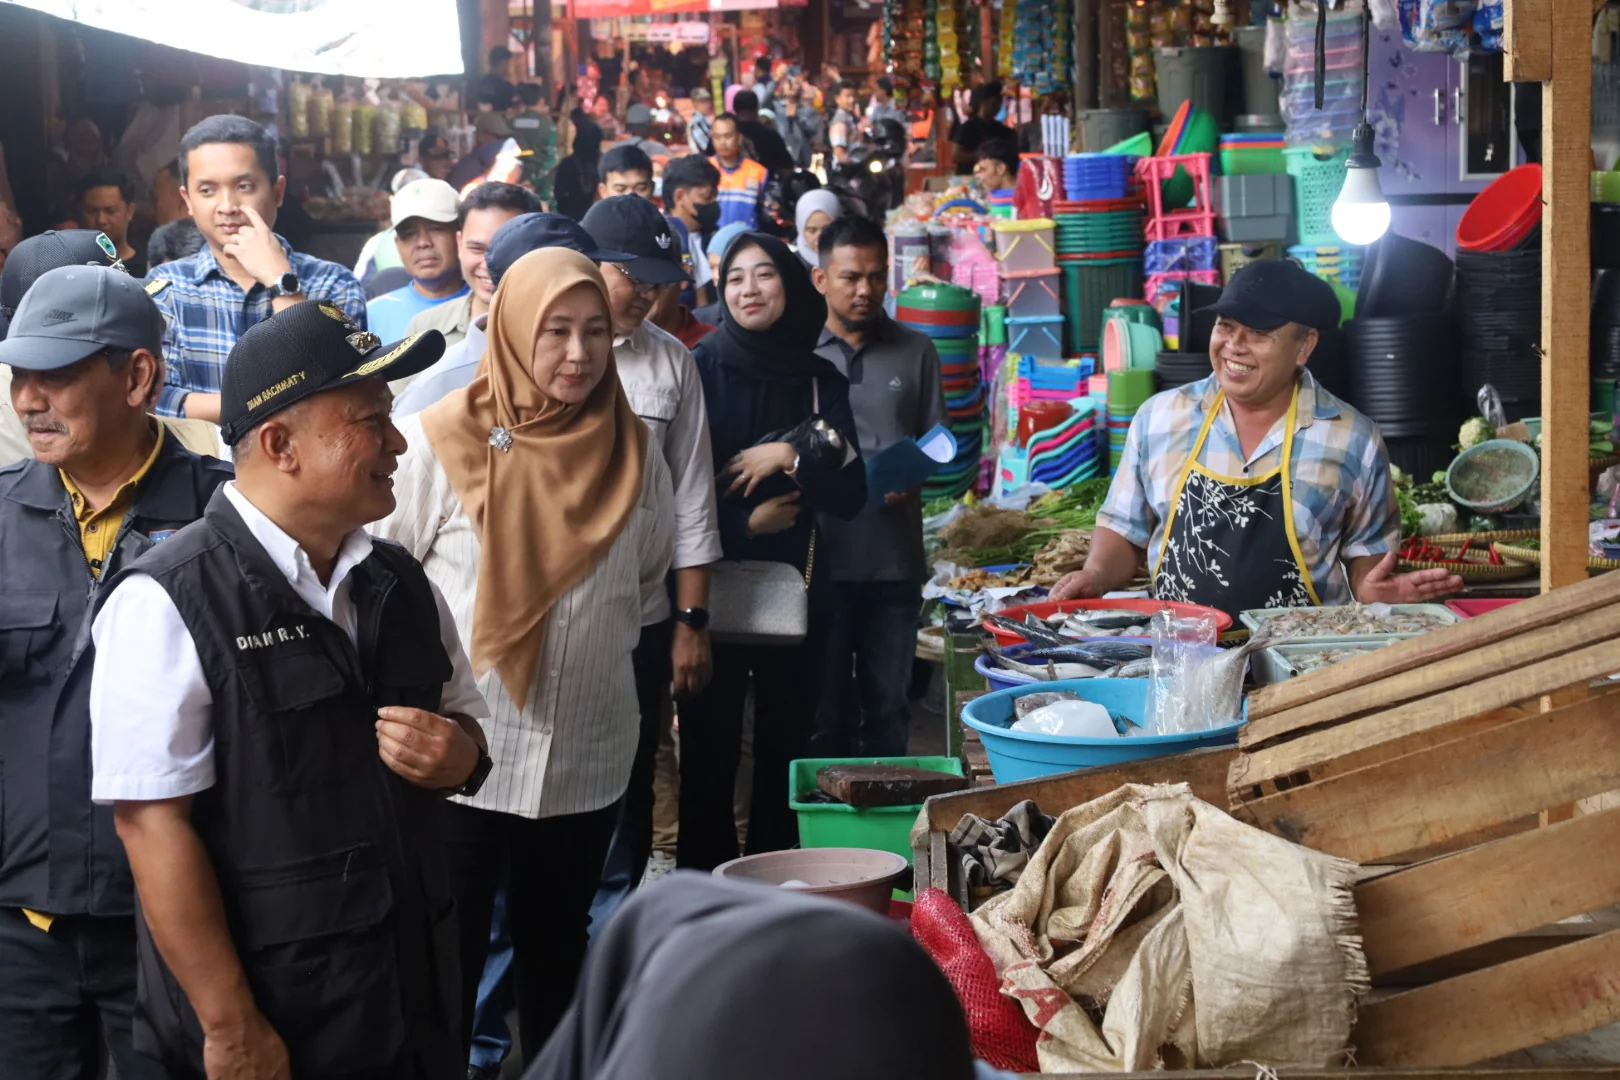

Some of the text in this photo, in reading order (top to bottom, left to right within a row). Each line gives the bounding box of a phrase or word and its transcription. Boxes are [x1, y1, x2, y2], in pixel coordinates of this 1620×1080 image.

[246, 394, 263, 411] DIAN
[236, 624, 310, 650] DIAN R. Y.
